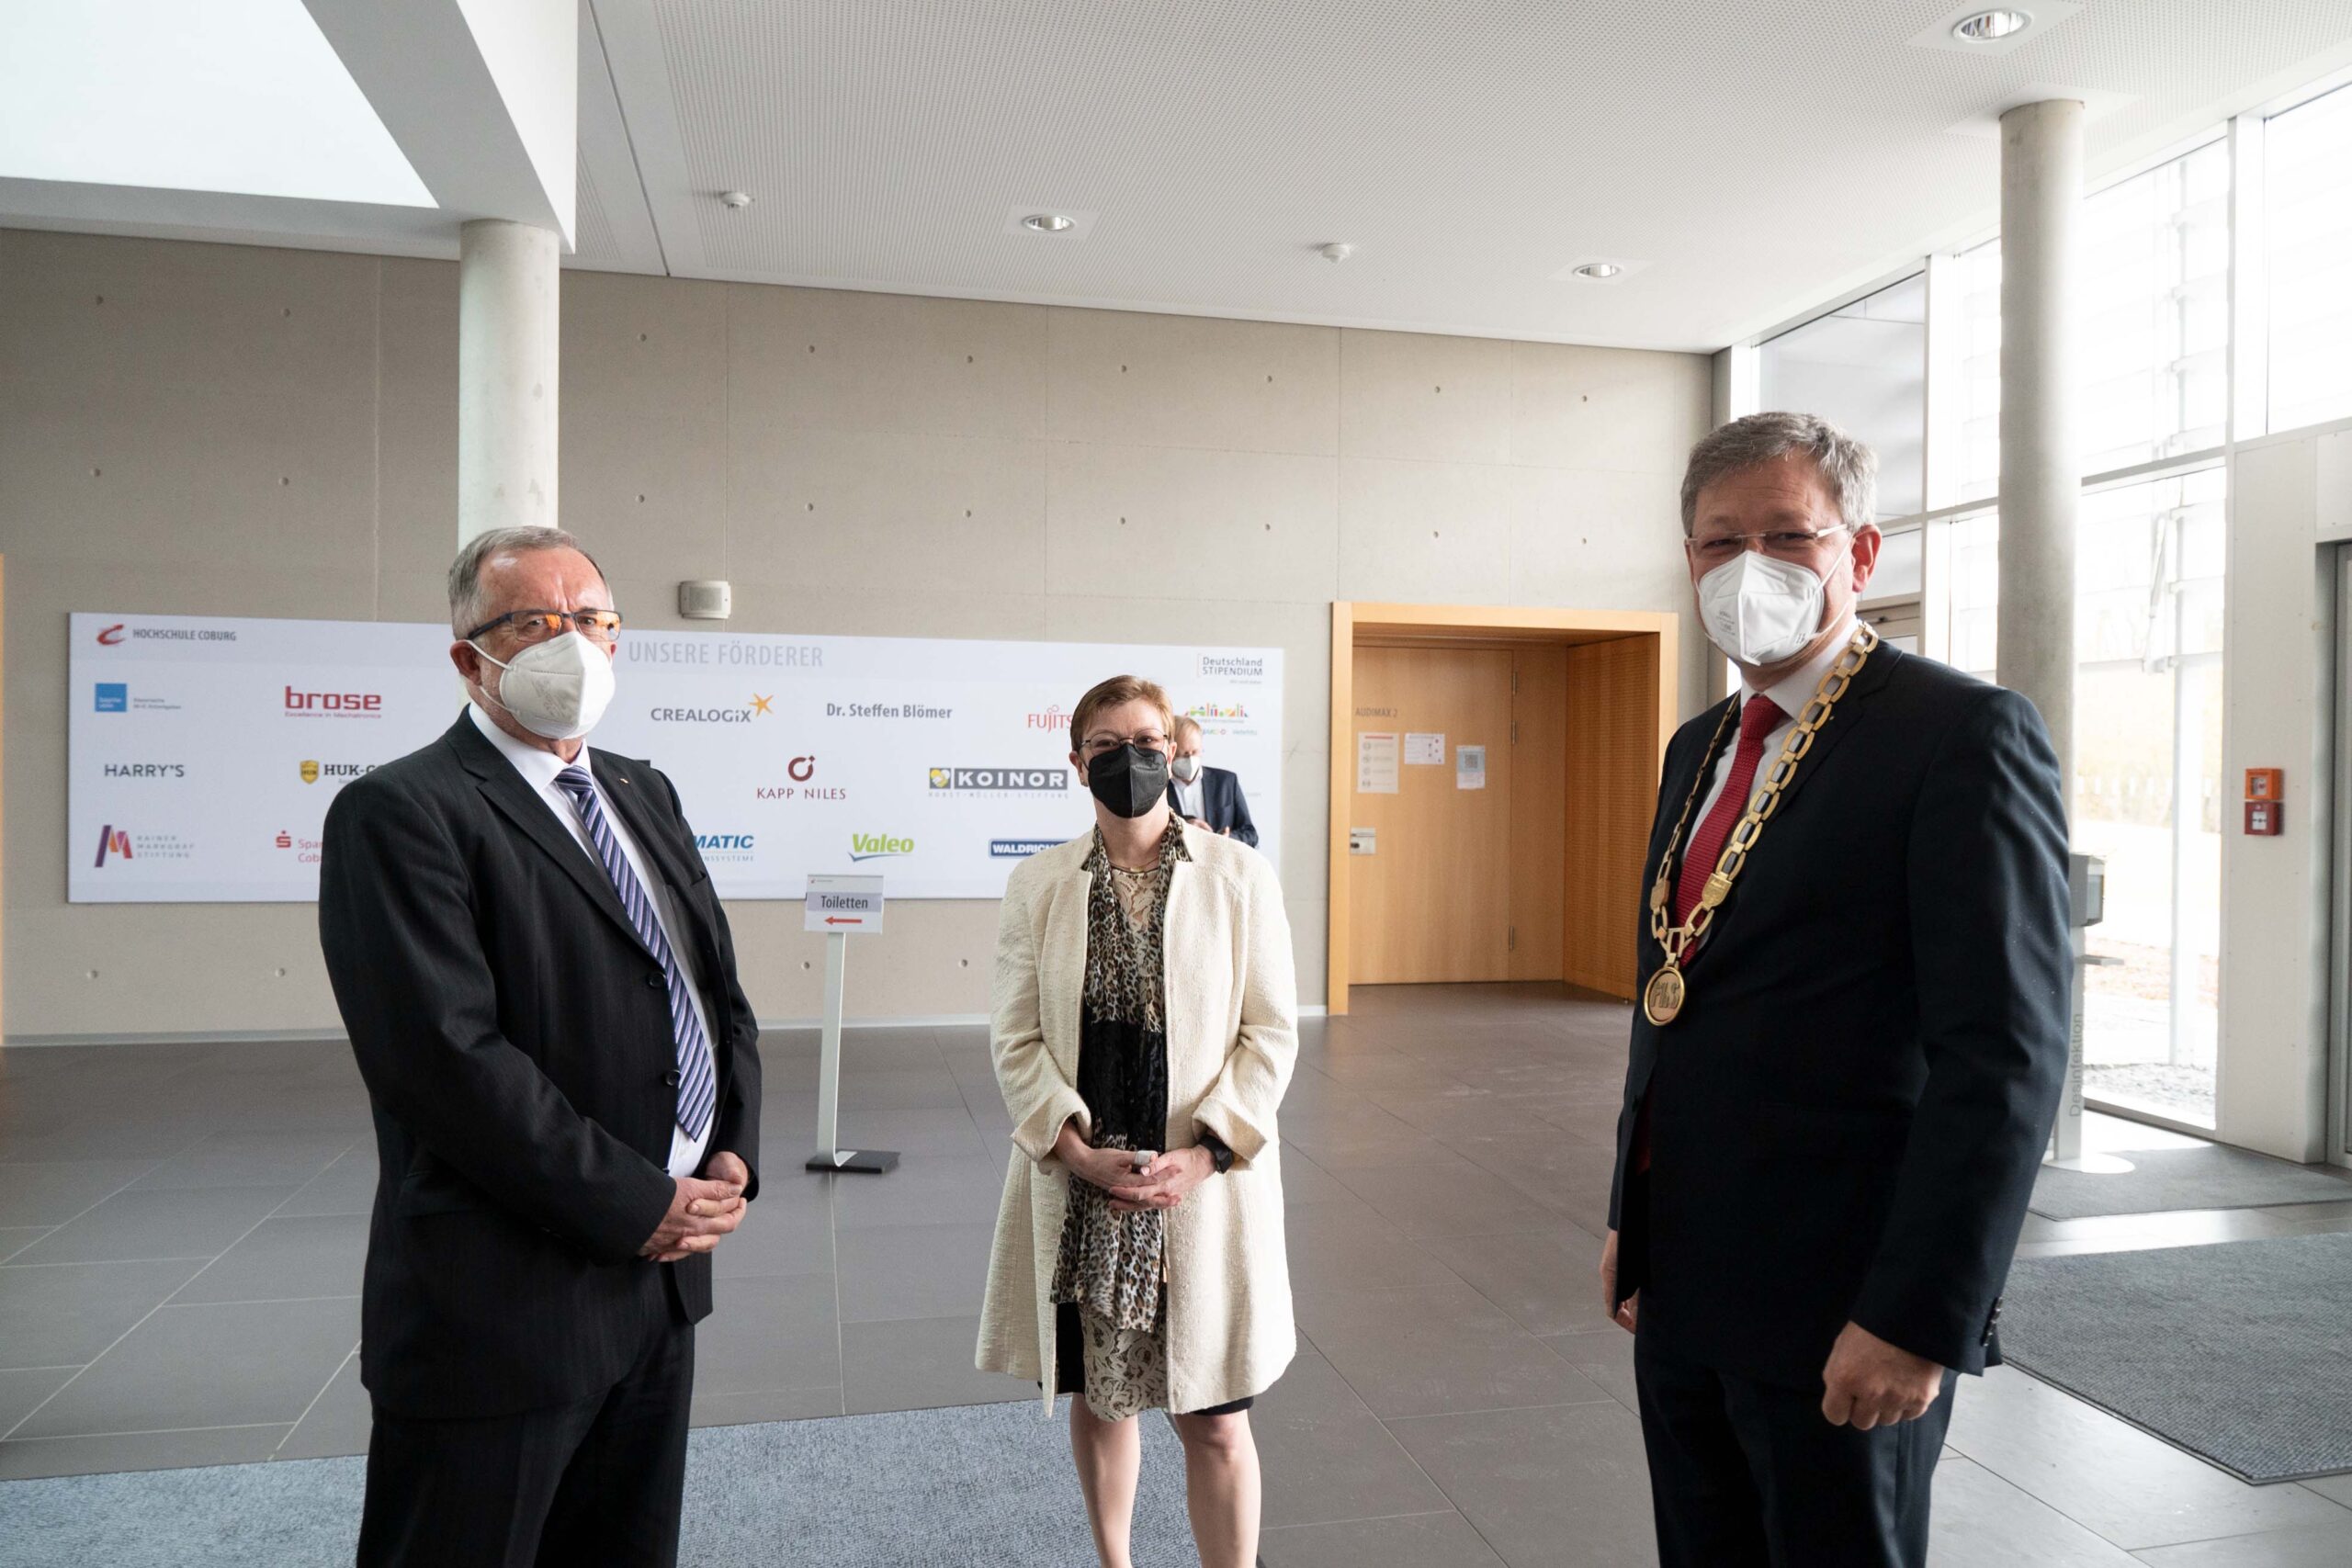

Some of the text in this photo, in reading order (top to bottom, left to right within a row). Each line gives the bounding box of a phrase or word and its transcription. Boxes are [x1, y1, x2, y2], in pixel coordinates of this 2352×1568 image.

[133, 628, 237, 641] HOCHSCHULE COBURG
[628, 640, 823, 667] UNSERE FÖRDERER
[1203, 656, 1262, 667] Deutschland
[1203, 666, 1262, 676] STIPENDIUM
[285, 685, 381, 710] brose
[826, 703, 953, 718] Dr. Steffen Blömer
[1355, 707, 1391, 717] AUDIMAX
[104, 763, 185, 777] HARRY'S
[958, 772, 1065, 787] KOINOR
[757, 788, 846, 800] KAPP NILES
[853, 833, 915, 853] Valeo
[298, 853, 322, 863] Cob
[821, 895, 868, 909] Toiletten
[2069, 1013, 2083, 1117] Desinfektion
